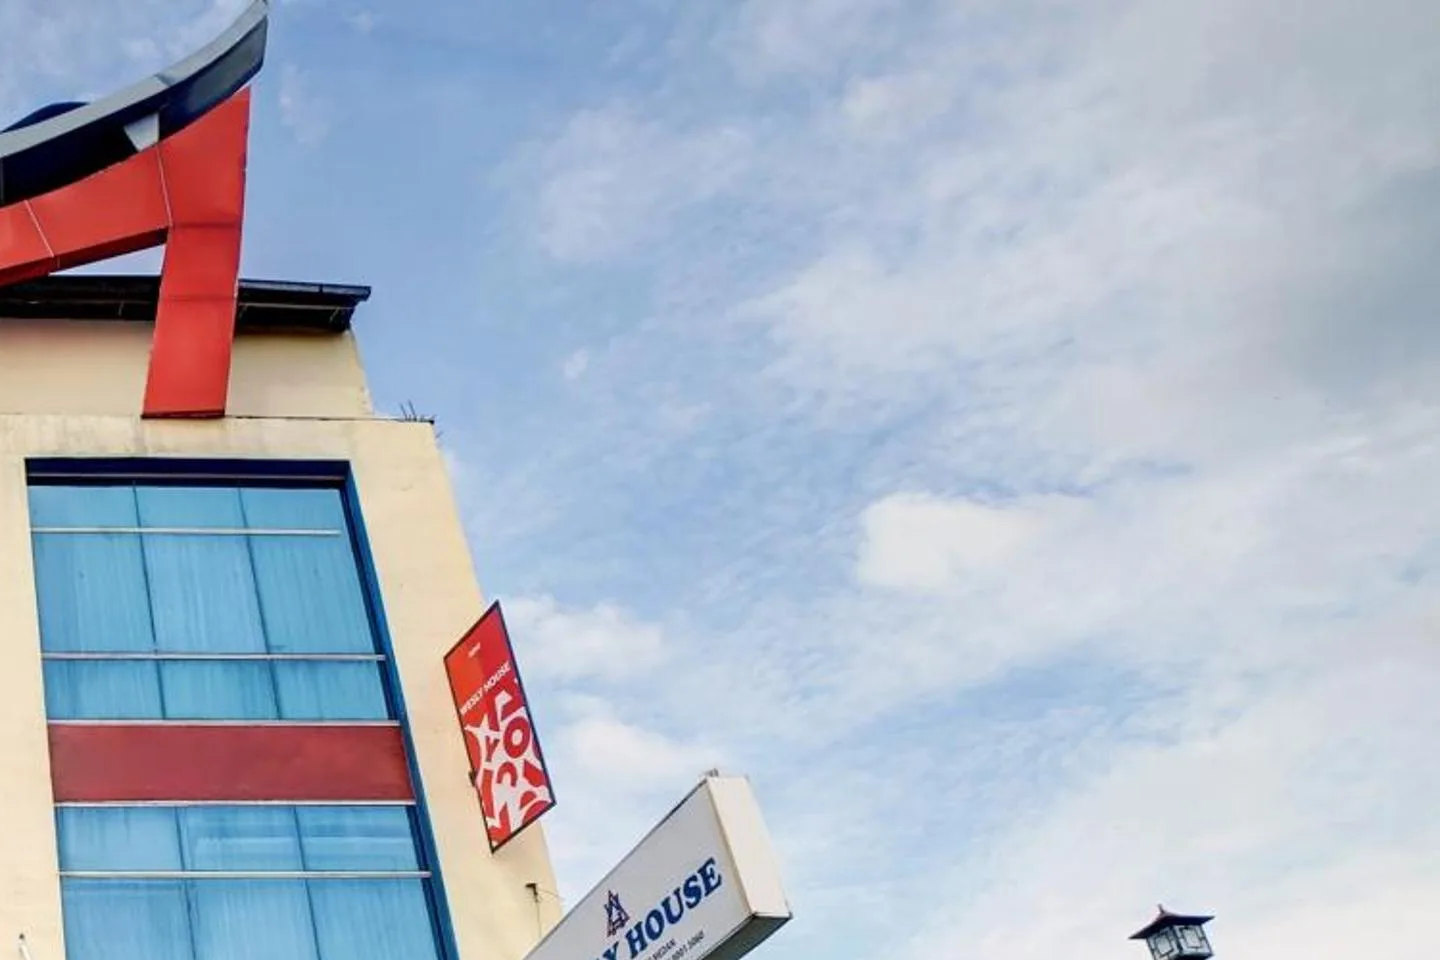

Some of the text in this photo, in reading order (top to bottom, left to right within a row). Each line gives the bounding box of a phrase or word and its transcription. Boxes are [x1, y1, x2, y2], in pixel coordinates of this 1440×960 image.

[460, 660, 511, 716] WESLY HOUSE
[625, 857, 723, 959] HOUSE
